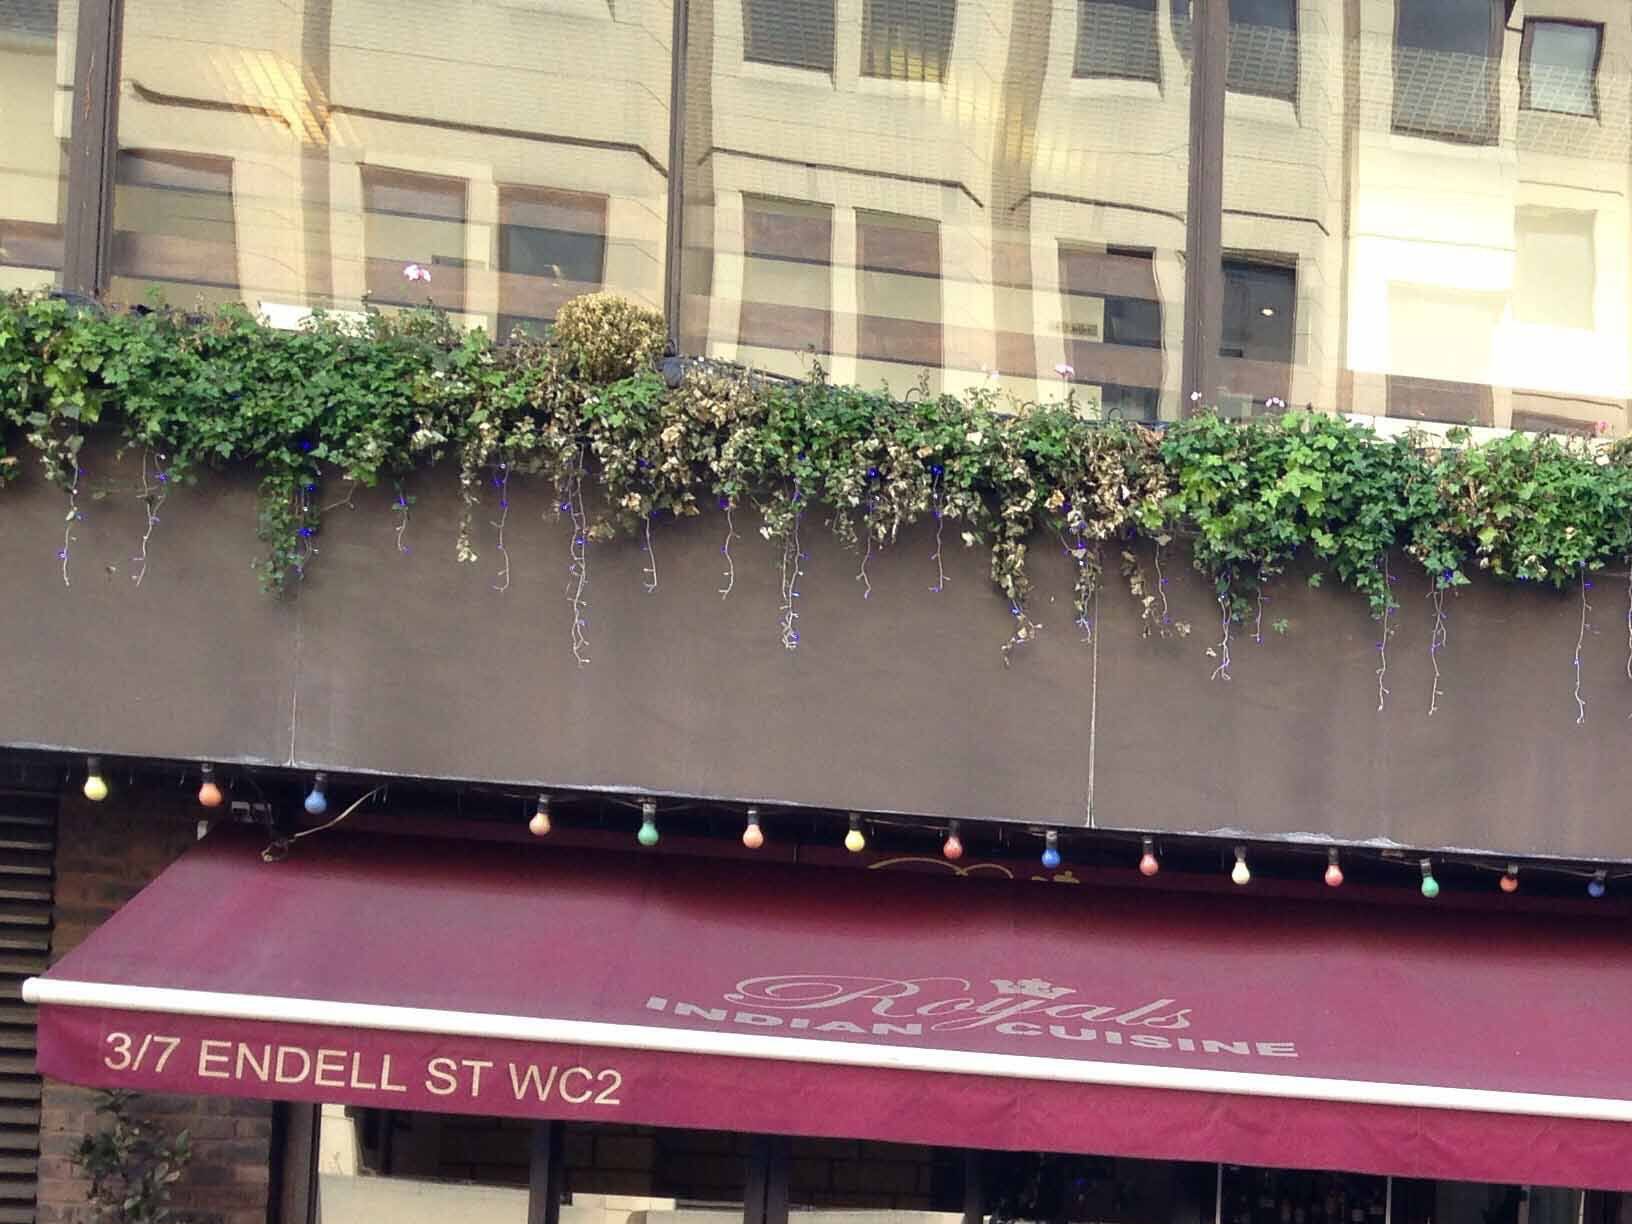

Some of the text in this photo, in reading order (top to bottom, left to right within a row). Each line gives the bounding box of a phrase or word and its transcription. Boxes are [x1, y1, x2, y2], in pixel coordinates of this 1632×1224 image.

[646, 996, 1299, 1057] INDIAN CUISINE
[723, 974, 1192, 1031] Royals
[104, 1032, 622, 1105] 3/7 ENDELL ST WC2
